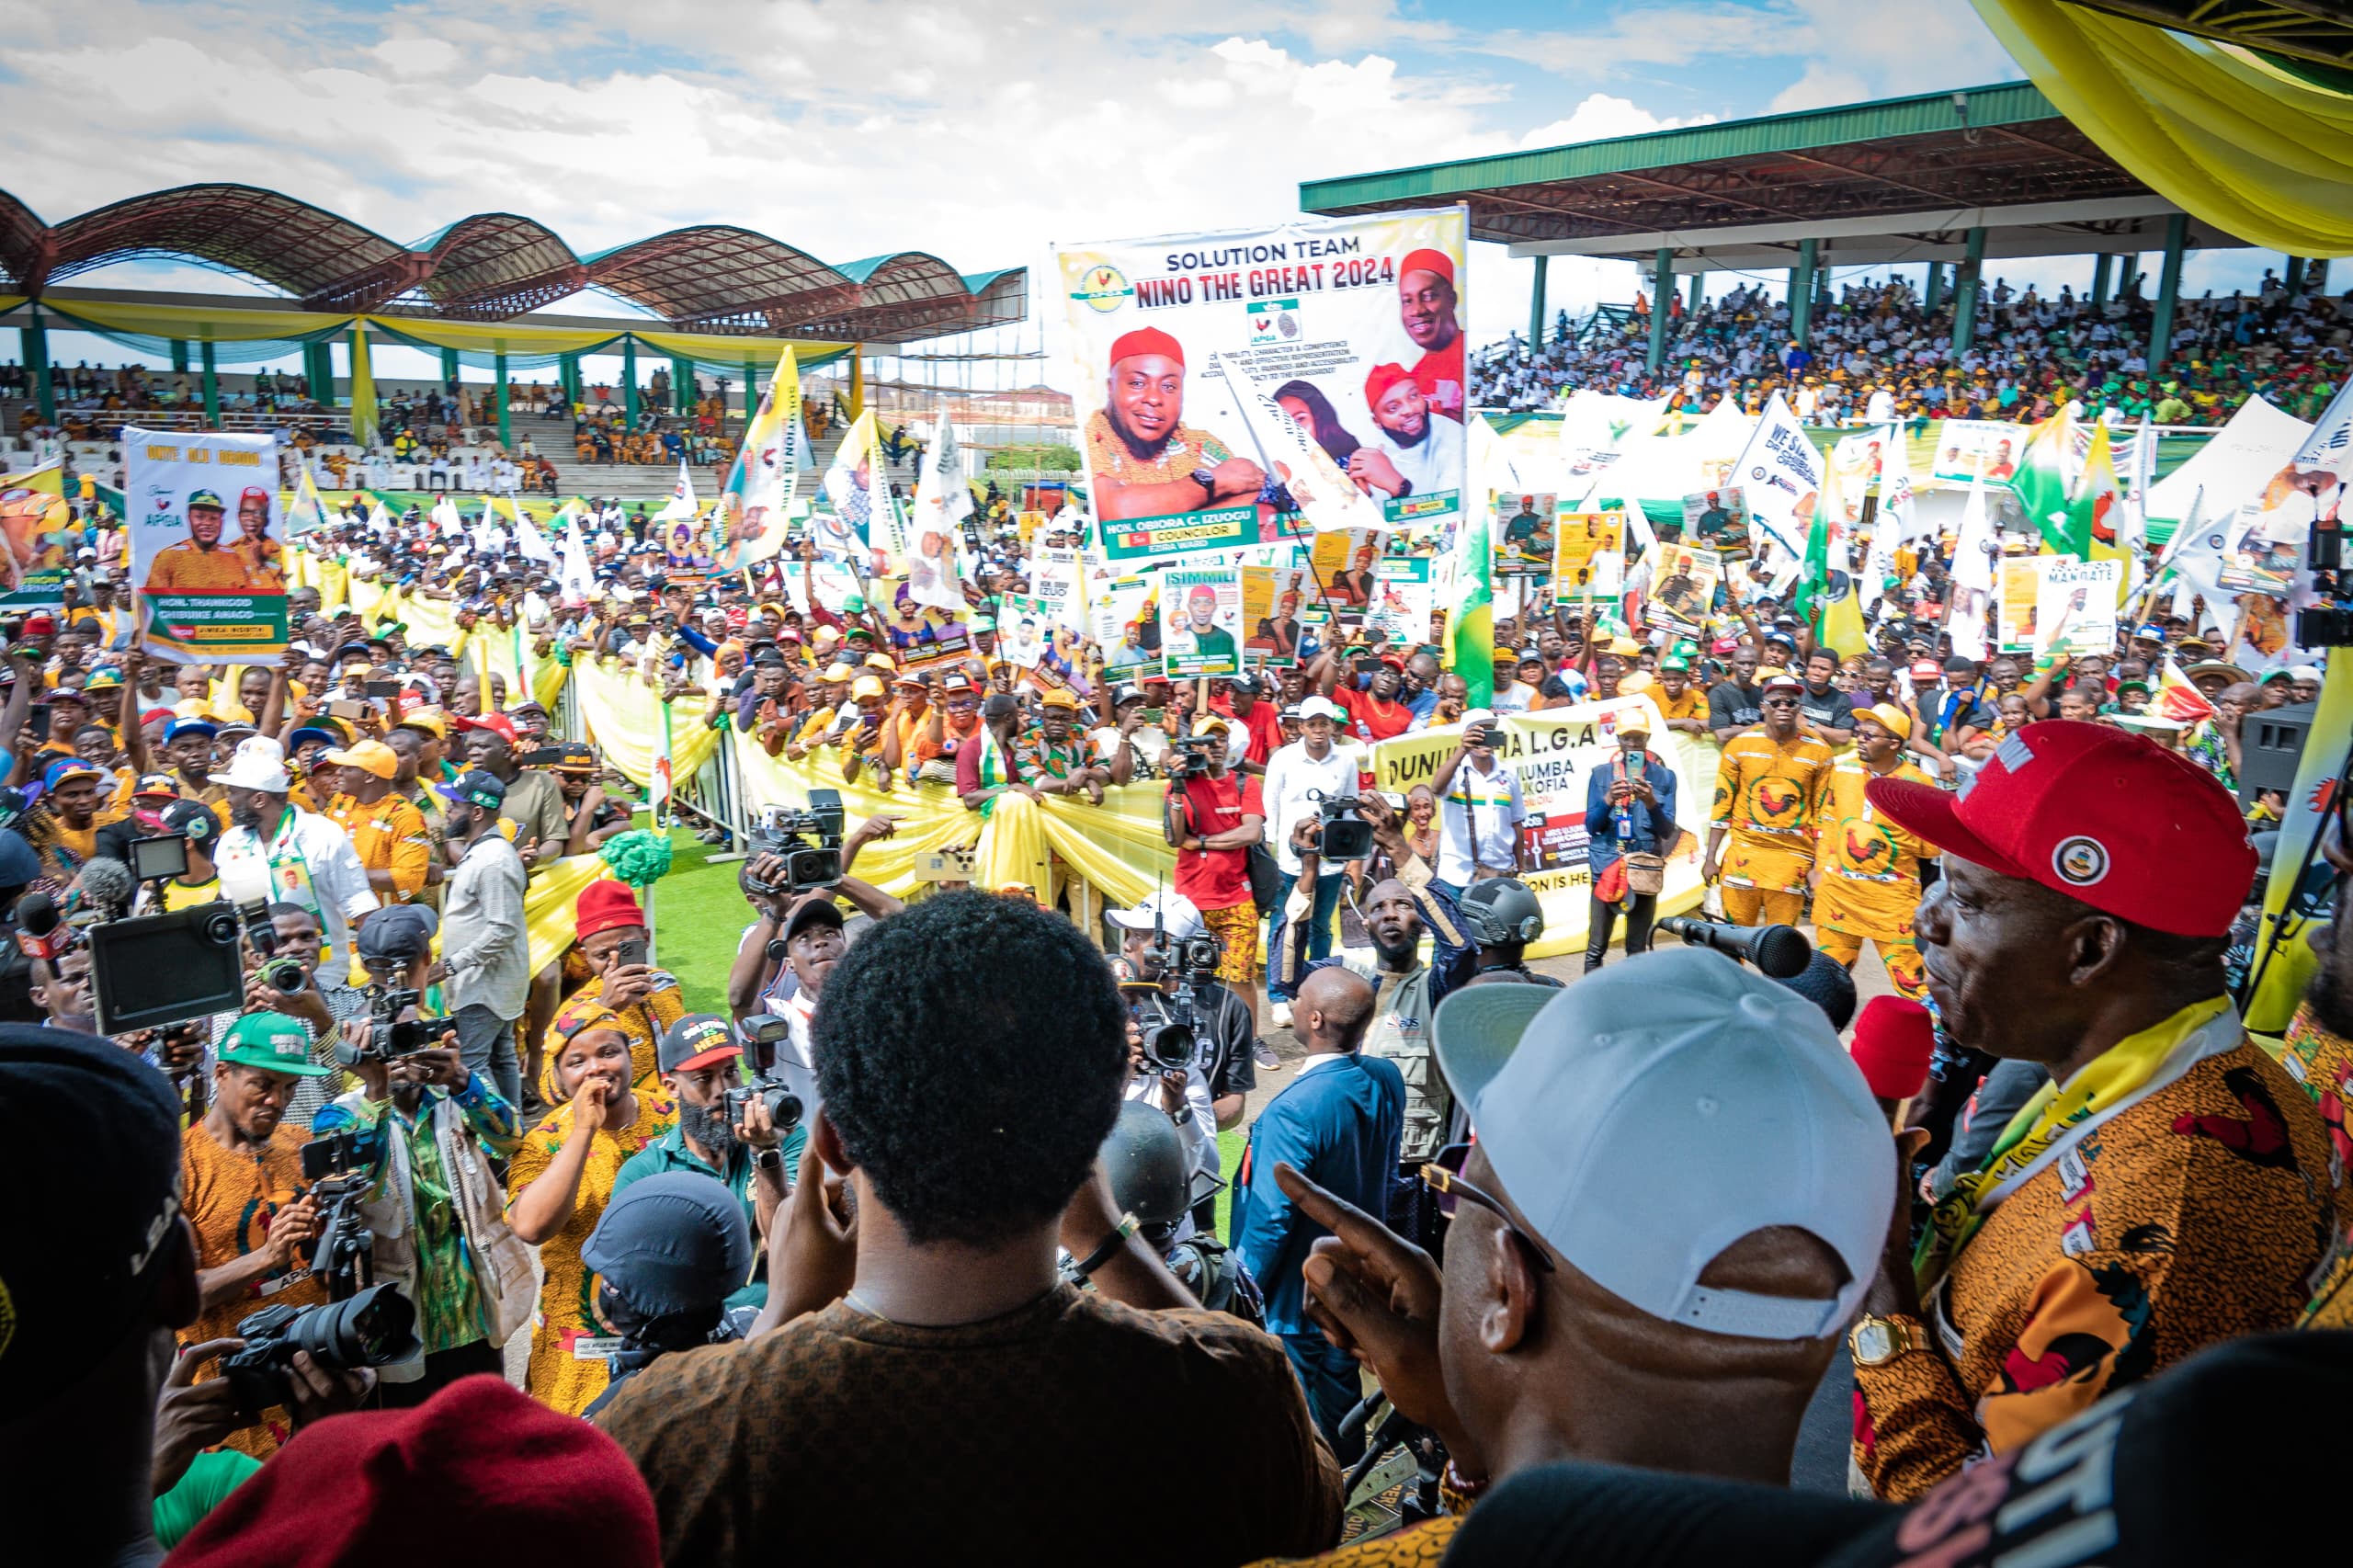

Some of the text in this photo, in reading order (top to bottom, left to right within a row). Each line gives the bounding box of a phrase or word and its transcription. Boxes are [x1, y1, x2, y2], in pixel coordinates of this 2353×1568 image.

[1166, 235, 1359, 272] SOLUTION TEAM
[1134, 256, 1394, 309] NINO THE GREAT 2024
[783, 386, 798, 457] SOLUTION
[1771, 423, 1791, 446] WE
[144, 514, 184, 527] APGA
[1106, 510, 1251, 535] HON. OBIORA C. IZUOGU
[1156, 526, 1230, 541] COUNCILOR
[1531, 723, 1597, 755] L.G.A
[1522, 815, 1544, 827] ote
[1553, 876, 1566, 889] IS
[1571, 871, 1588, 886] HE
[1846, 872, 1890, 882] APGA
[693, 1032, 729, 1054] HERE
[279, 1267, 313, 1290] APG
